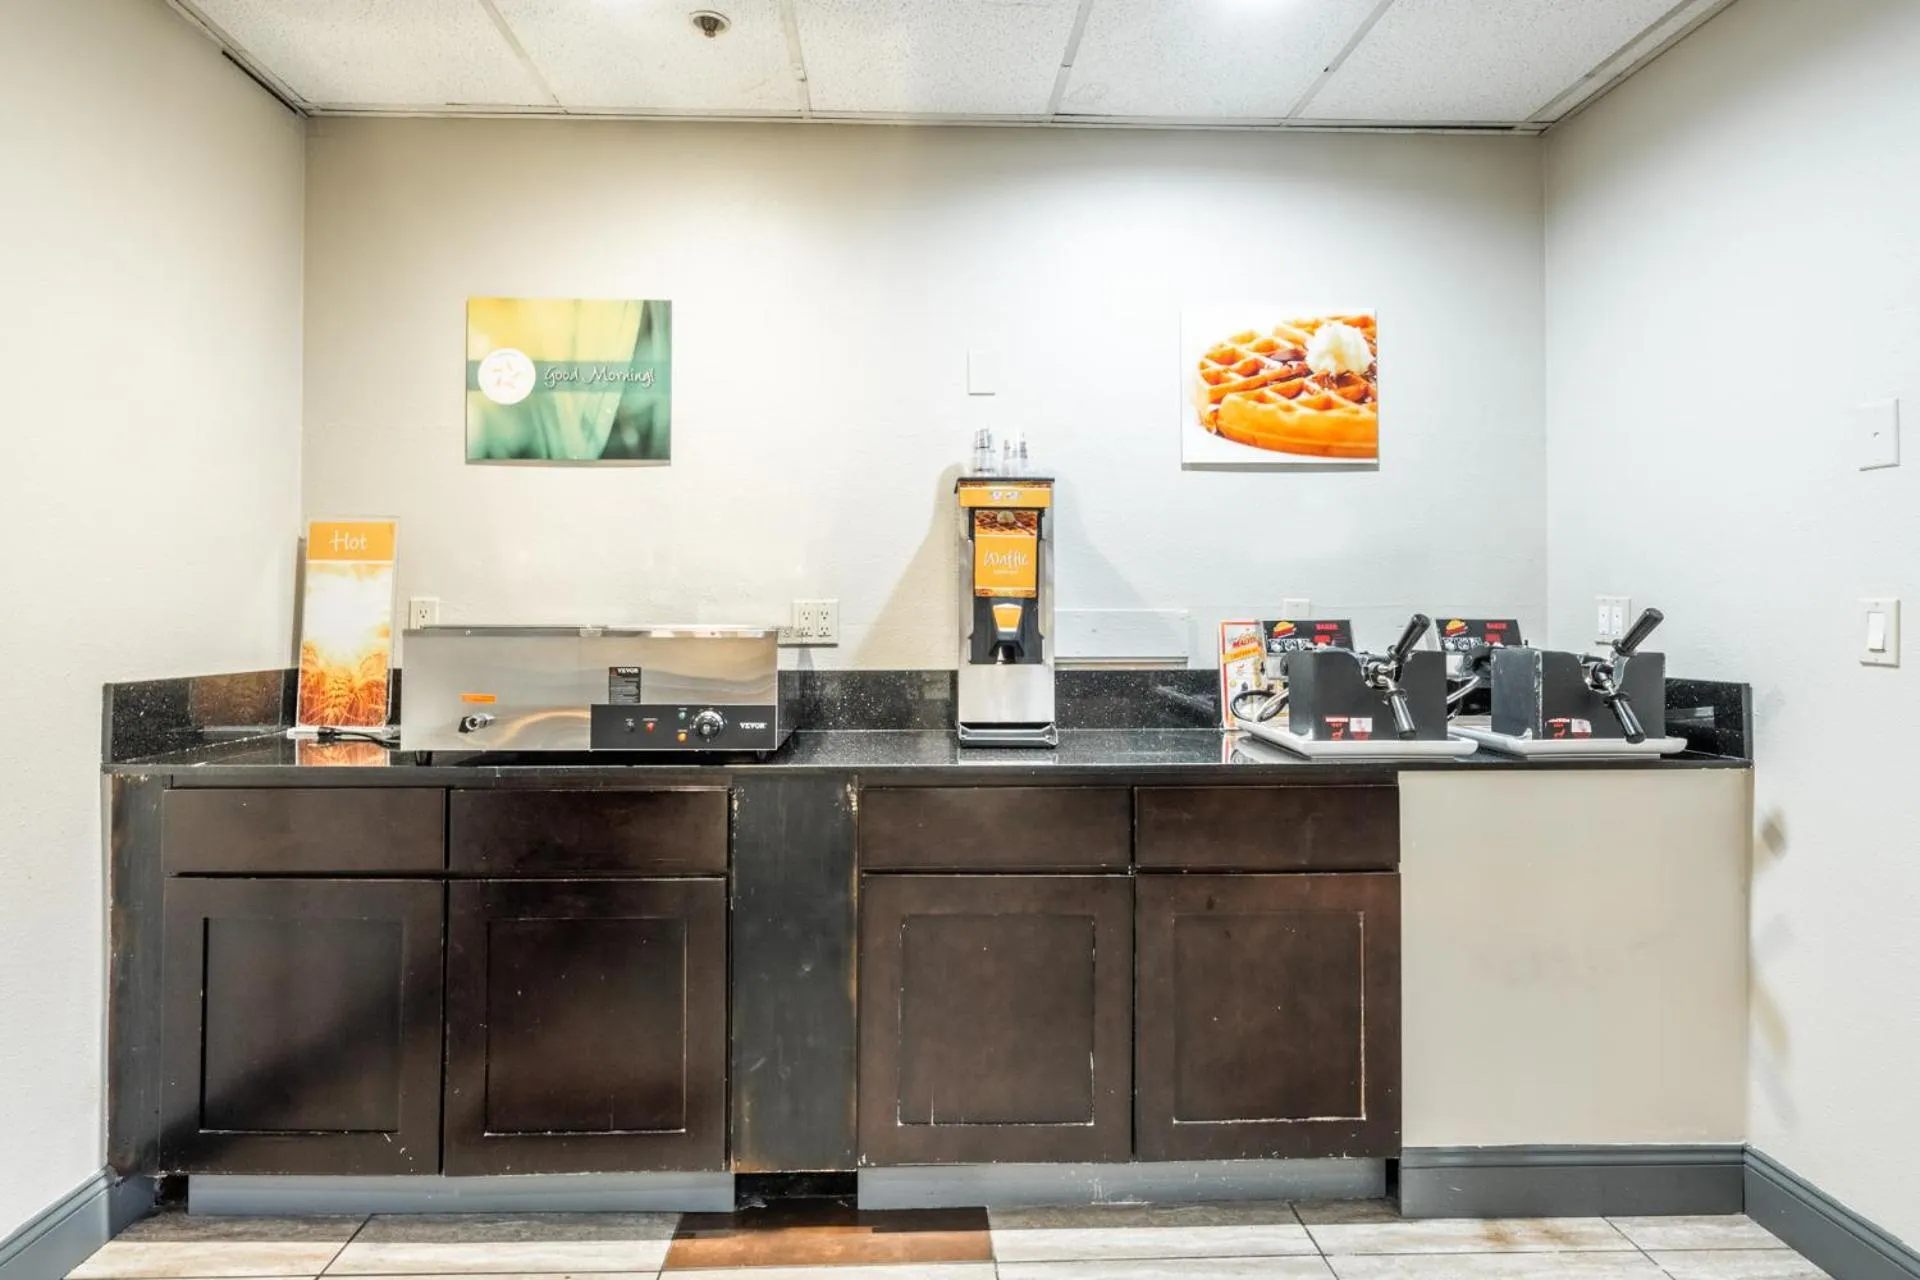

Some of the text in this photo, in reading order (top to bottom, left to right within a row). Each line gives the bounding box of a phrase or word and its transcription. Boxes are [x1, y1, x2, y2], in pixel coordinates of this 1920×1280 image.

[544, 365, 656, 389] Good Morning!
[329, 529, 367, 553] Hot
[984, 548, 1029, 569] Waffle
